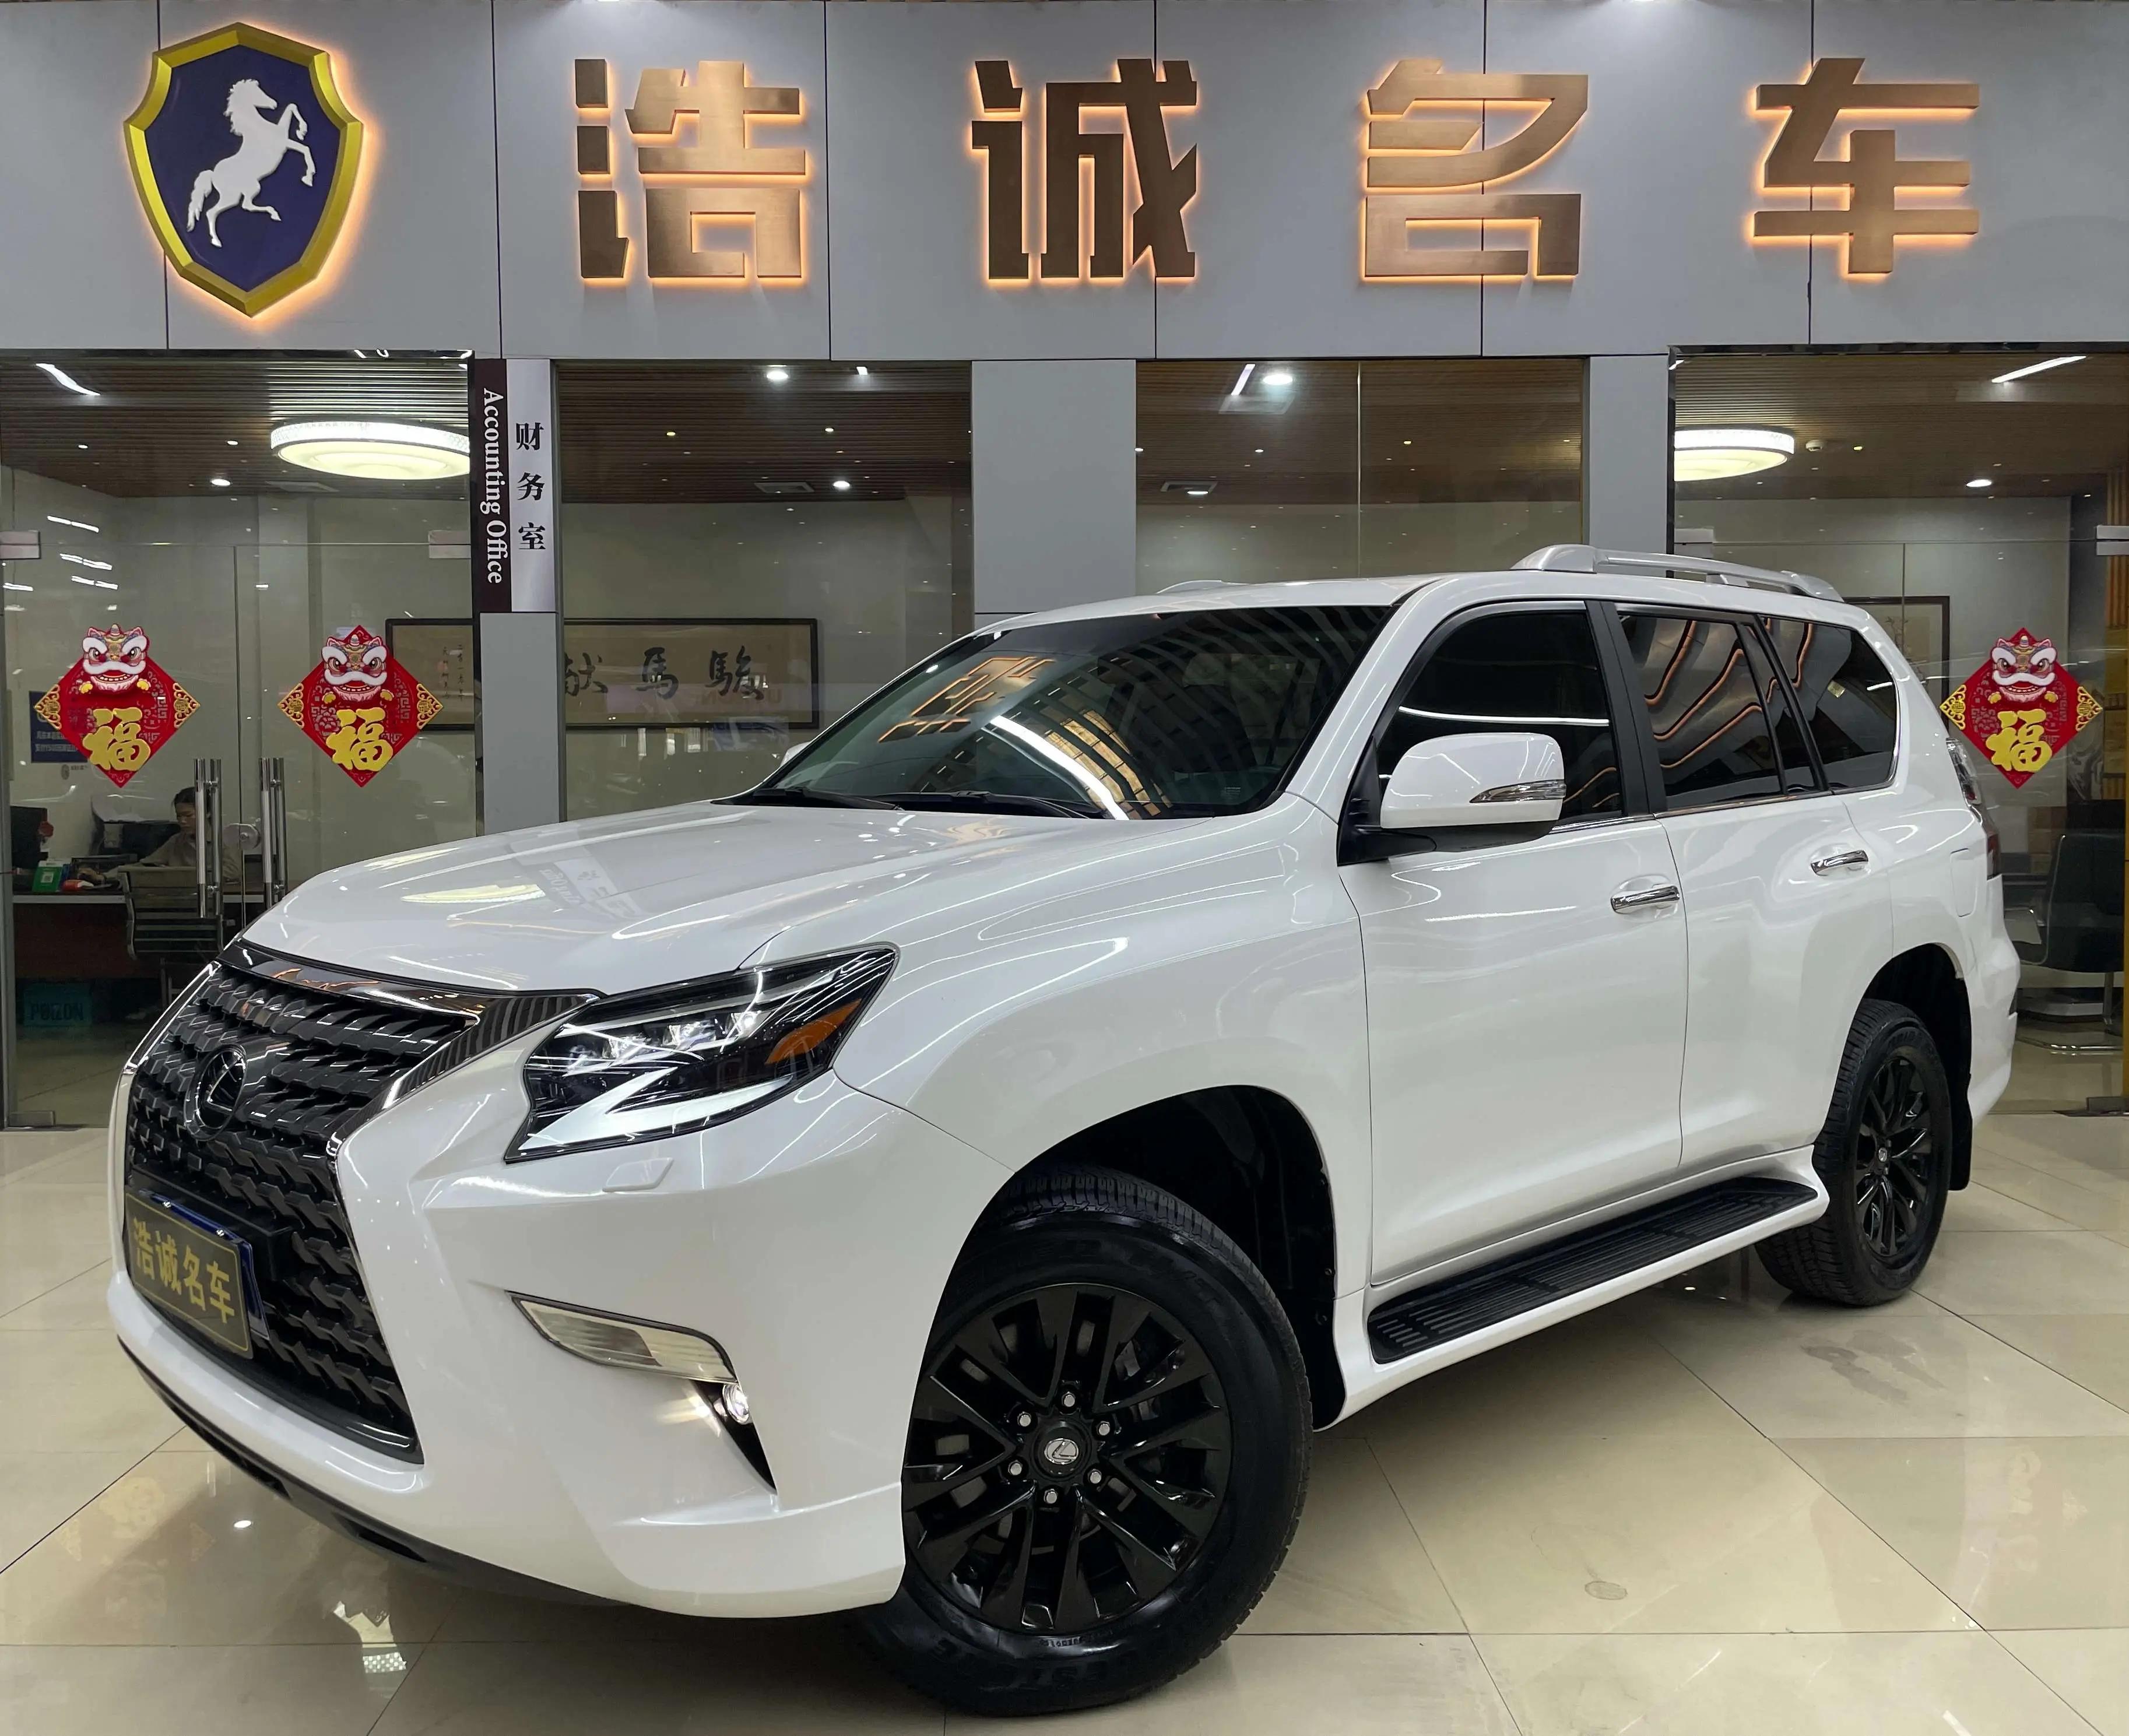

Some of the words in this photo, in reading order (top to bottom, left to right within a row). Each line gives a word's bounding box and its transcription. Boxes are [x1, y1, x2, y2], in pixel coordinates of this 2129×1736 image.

[574, 58, 1980, 279] 浩诚名车
[480, 387, 505, 515] Accounting
[515, 422, 546, 550] 财务室
[486, 519, 508, 584] Office
[83, 708, 150, 771] 福
[326, 707, 393, 771] 福
[1986, 709, 2052, 772] 福
[133, 1217, 234, 1324] 浩诚名车
